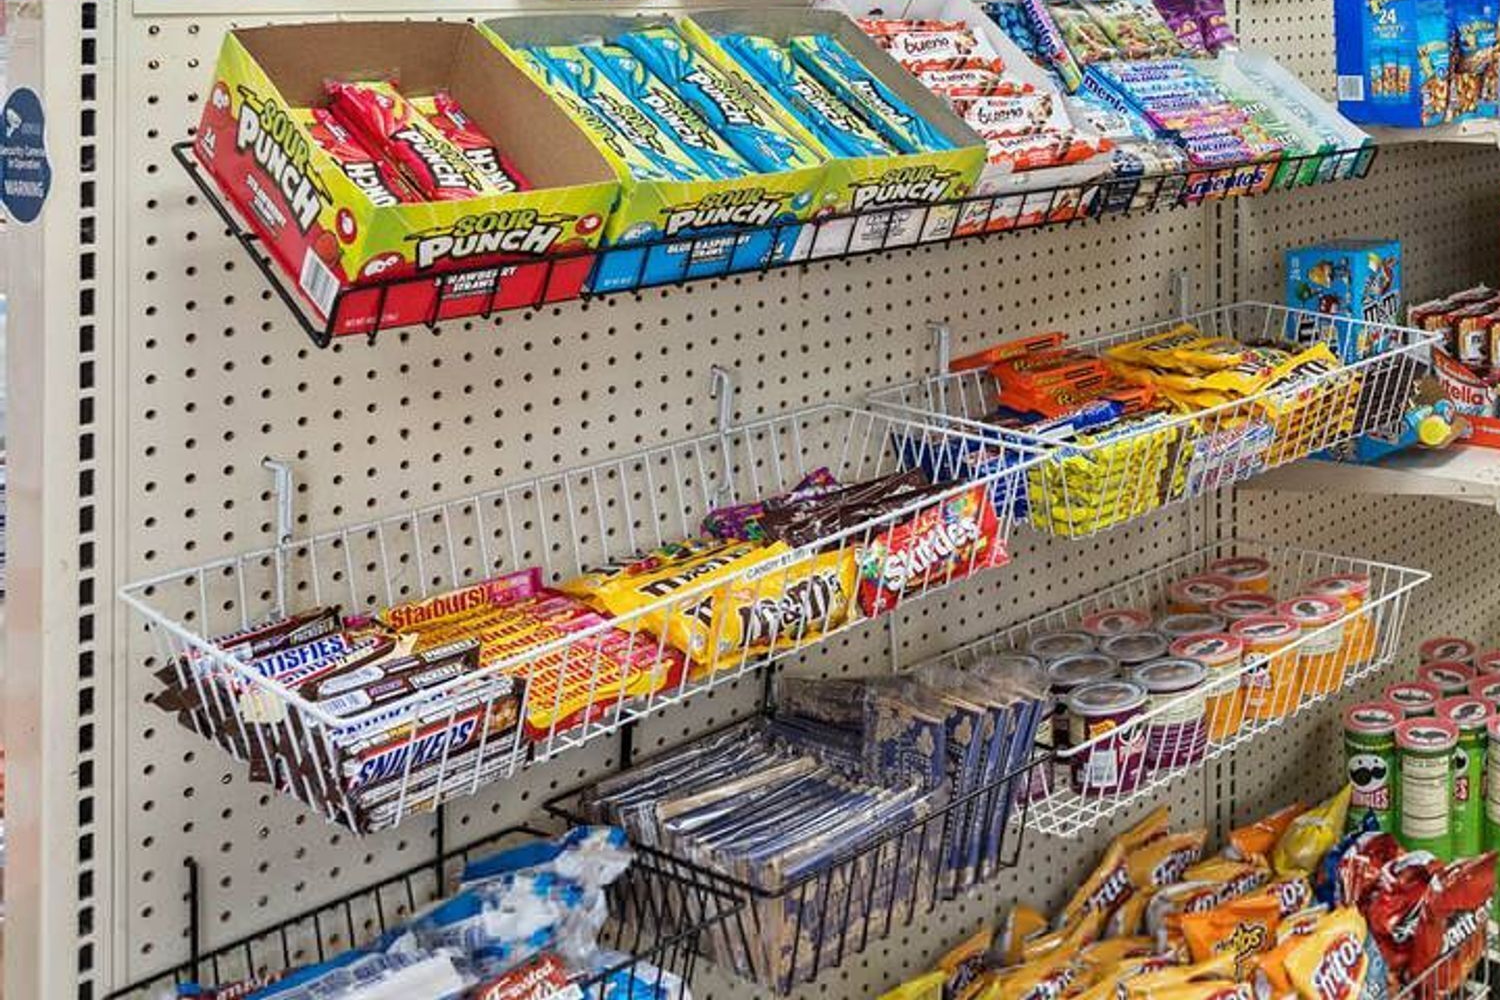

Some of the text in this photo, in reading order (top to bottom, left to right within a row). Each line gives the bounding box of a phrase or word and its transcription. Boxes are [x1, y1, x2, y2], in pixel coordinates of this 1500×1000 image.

[1379, 8, 1397, 24] 24
[904, 35, 949, 53] bueno
[686, 71, 750, 125] PUNCH
[977, 106, 1023, 124] bueno
[261, 99, 309, 172] SOUR
[642, 94, 703, 148] PUNCH
[237, 104, 322, 231] PUNCH
[396, 130, 468, 188] PUNCH
[882, 165, 936, 187] SOUR
[699, 188, 766, 209] SOUR
[856, 177, 951, 210] PUNCH
[453, 209, 537, 237] SOUR
[667, 202, 780, 238] PUNCH
[417, 224, 562, 270] PUNCH
